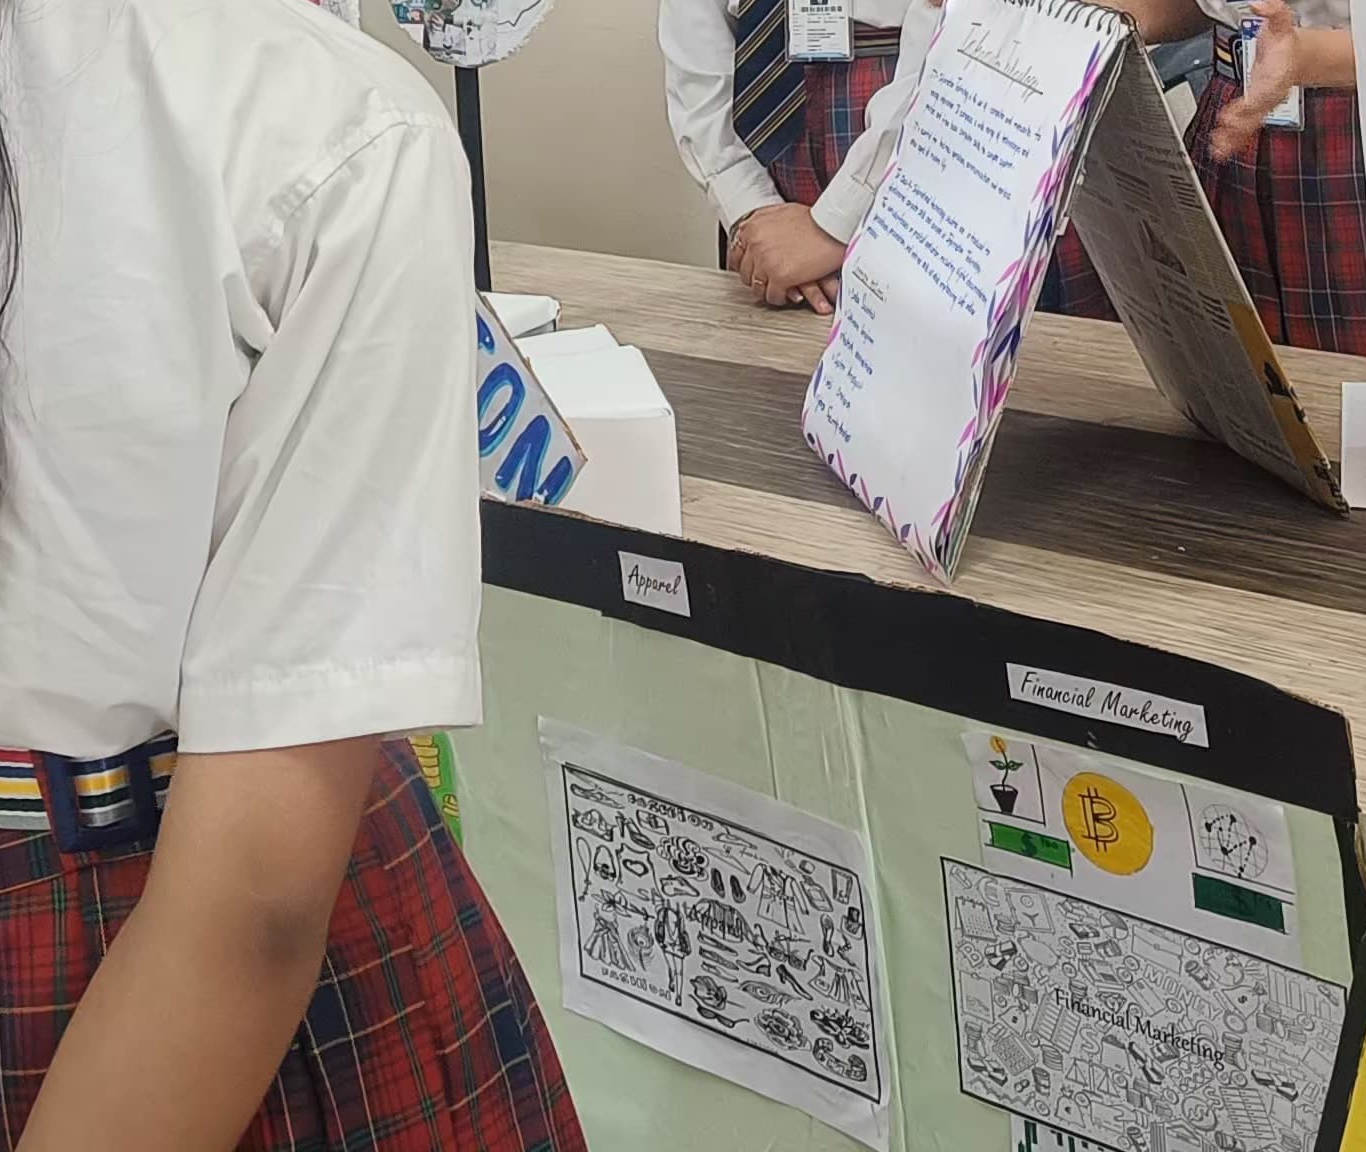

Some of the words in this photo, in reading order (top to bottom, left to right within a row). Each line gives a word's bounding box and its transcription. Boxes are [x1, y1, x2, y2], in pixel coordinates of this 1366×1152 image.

[627, 564, 682, 597] Apparel
[1020, 670, 1097, 709] Financial
[1099, 689, 1195, 743] Marketing
[1142, 963, 1225, 1022] MONEY
[1053, 986, 1132, 1031] Financial
[1133, 1013, 1226, 1072] Marketing
